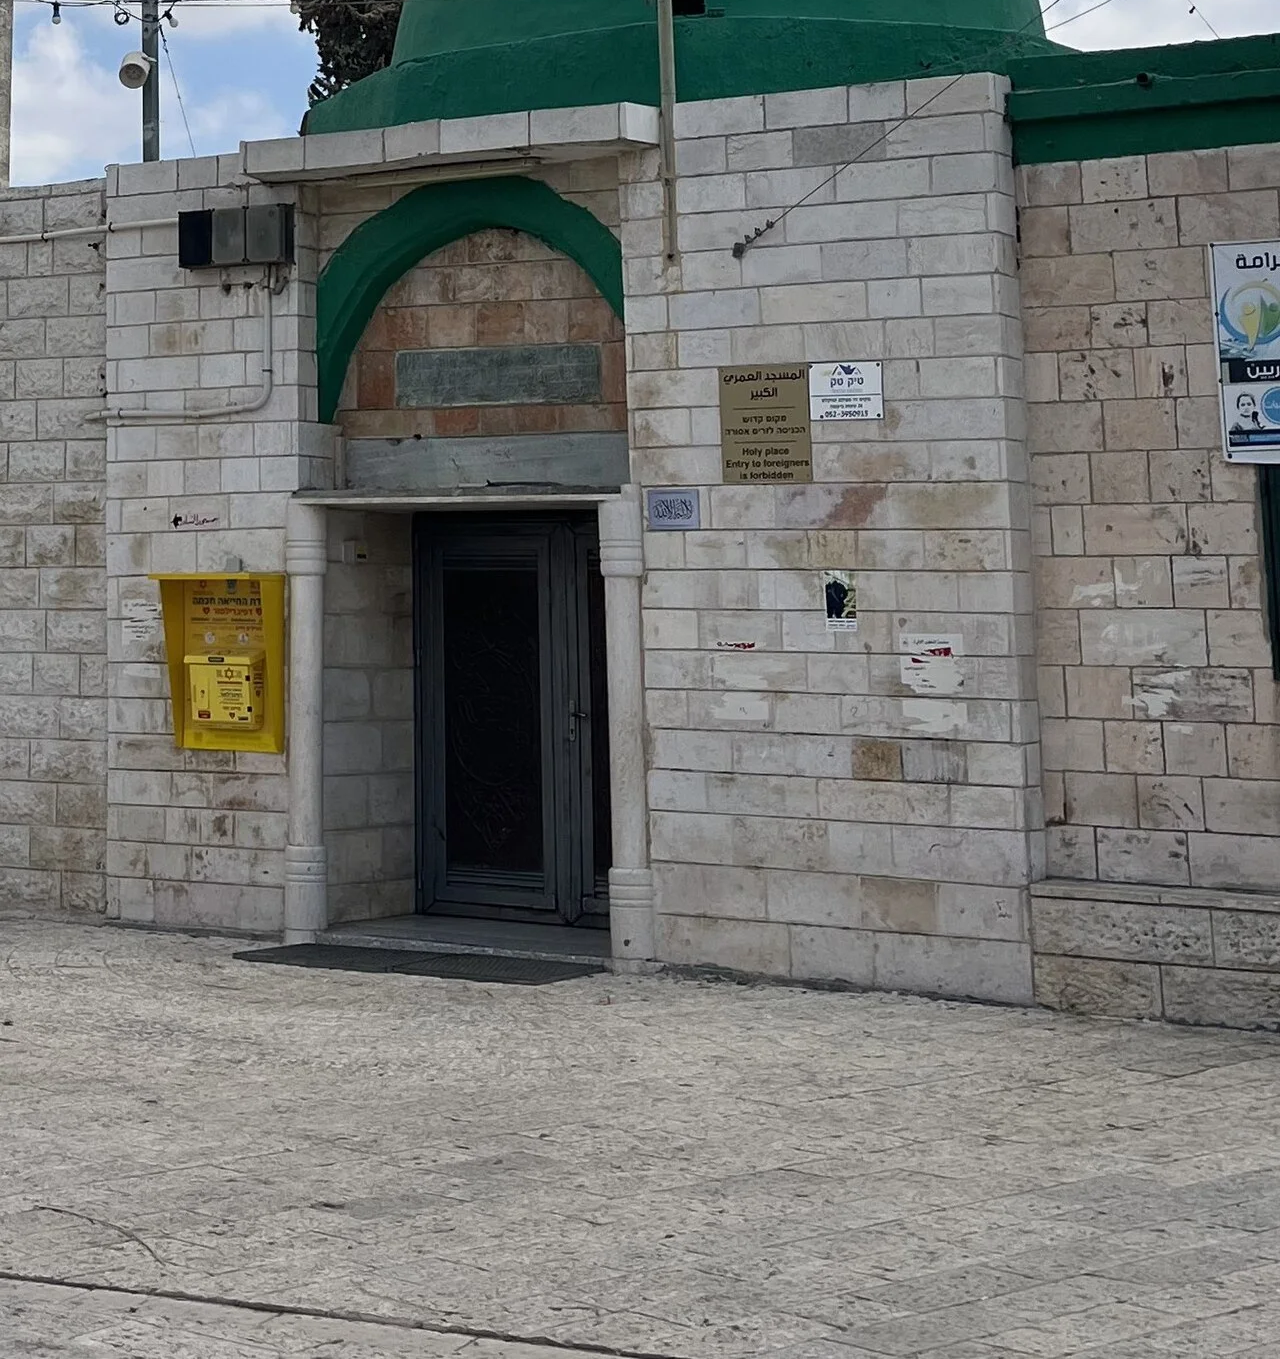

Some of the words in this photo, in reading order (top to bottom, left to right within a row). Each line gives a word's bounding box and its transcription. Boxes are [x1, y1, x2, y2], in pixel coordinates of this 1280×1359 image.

[1236, 252, 1280, 271] رامة
[723, 371, 762, 385] العمري
[764, 369, 805, 382] المسجد
[830, 377, 844, 388] טק
[847, 376, 864, 388] טיק
[750, 387, 778, 400] الكبير
[742, 416, 763, 424] קדוש
[766, 415, 787, 424] מקום
[725, 428, 750, 436] אסורה
[752, 426, 774, 435] לזרים
[776, 426, 806, 435] הכניסה
[742, 447, 763, 457] Holy
[765, 447, 790, 457] place
[726, 459, 750, 469] Entry
[752, 460, 761, 468] to
[763, 459, 810, 469] foreigners
[740, 472, 748, 480] is
[750, 471, 794, 480] forbidden
